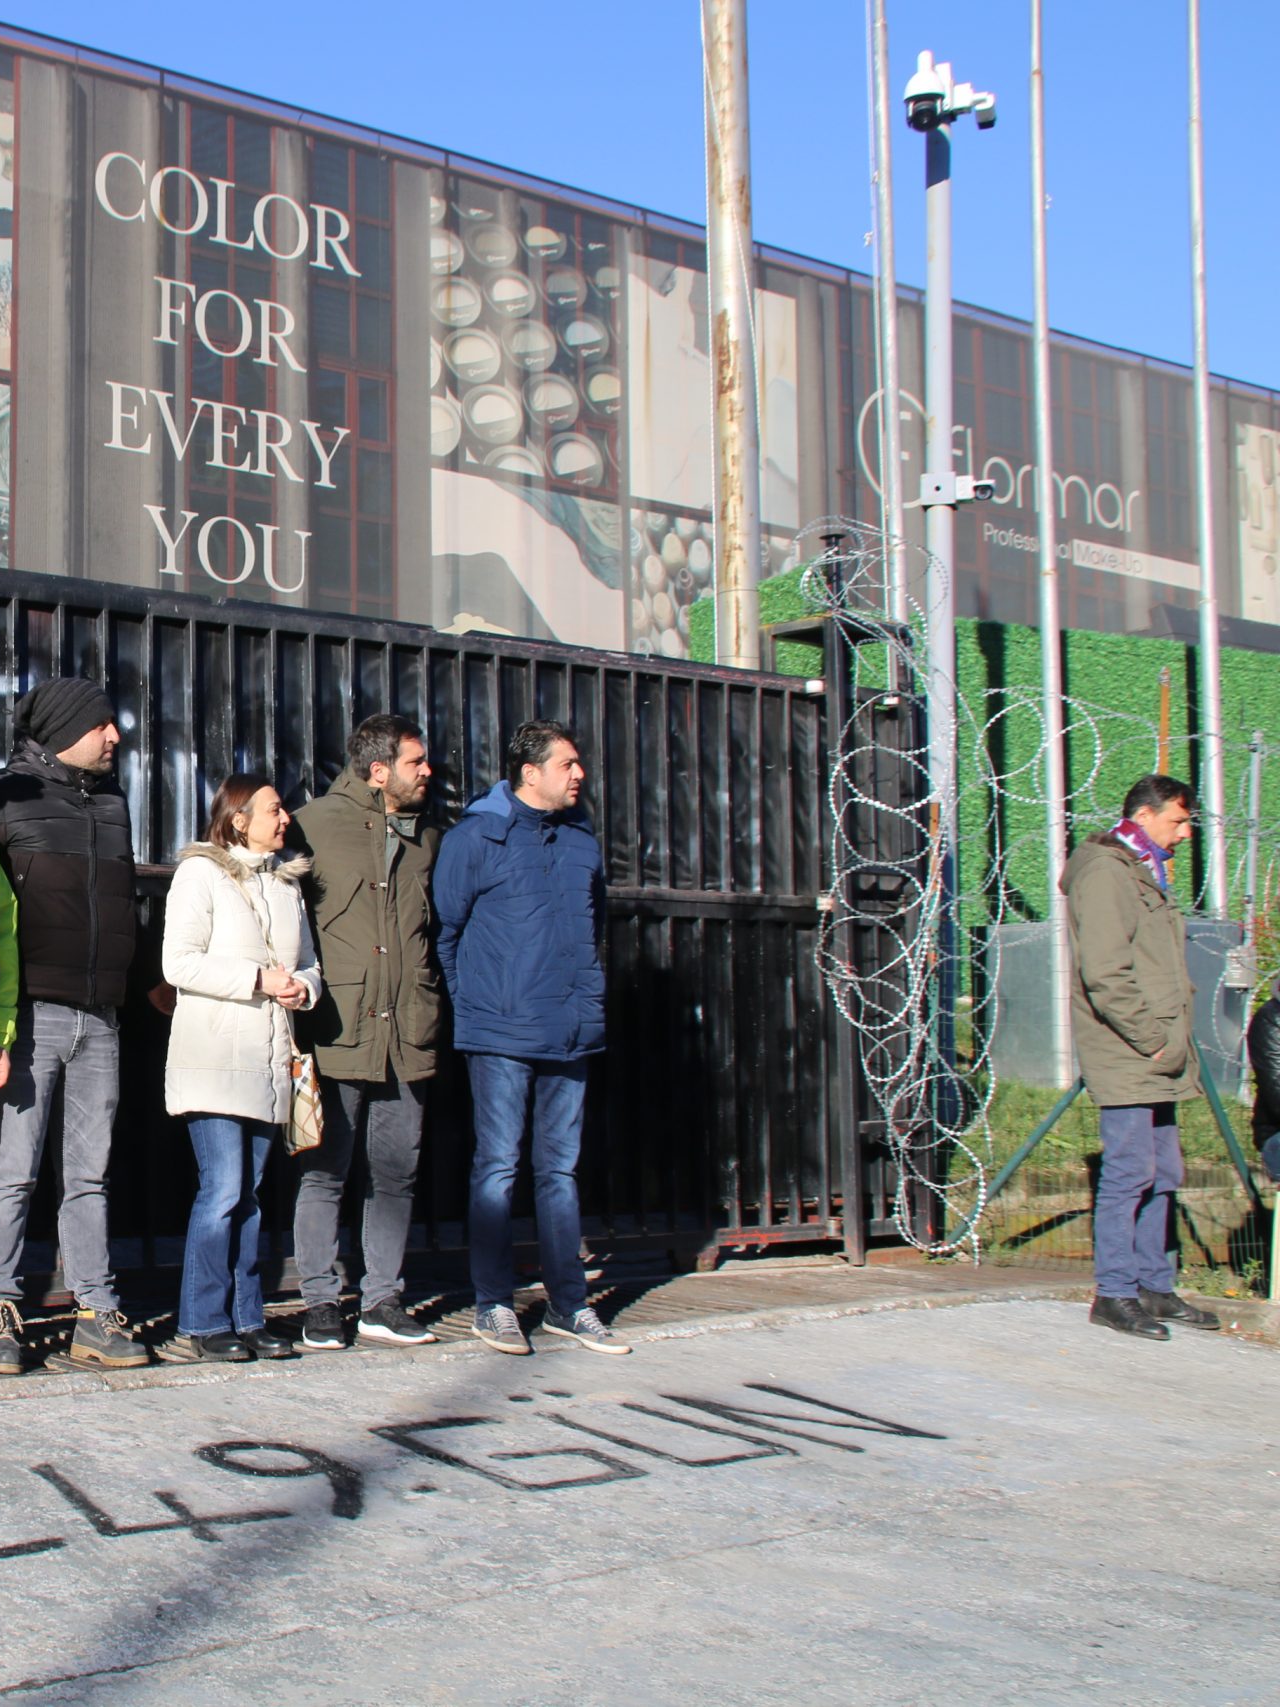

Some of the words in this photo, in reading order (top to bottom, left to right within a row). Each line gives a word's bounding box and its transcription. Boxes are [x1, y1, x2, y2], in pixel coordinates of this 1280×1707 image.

[95, 151, 362, 277] COLOR
[153, 276, 307, 373] FOR
[104, 380, 351, 488] EVERY
[143, 503, 312, 593] YOU
[983, 522, 1072, 560] Professial
[1076, 543, 1143, 575] Make-Up
